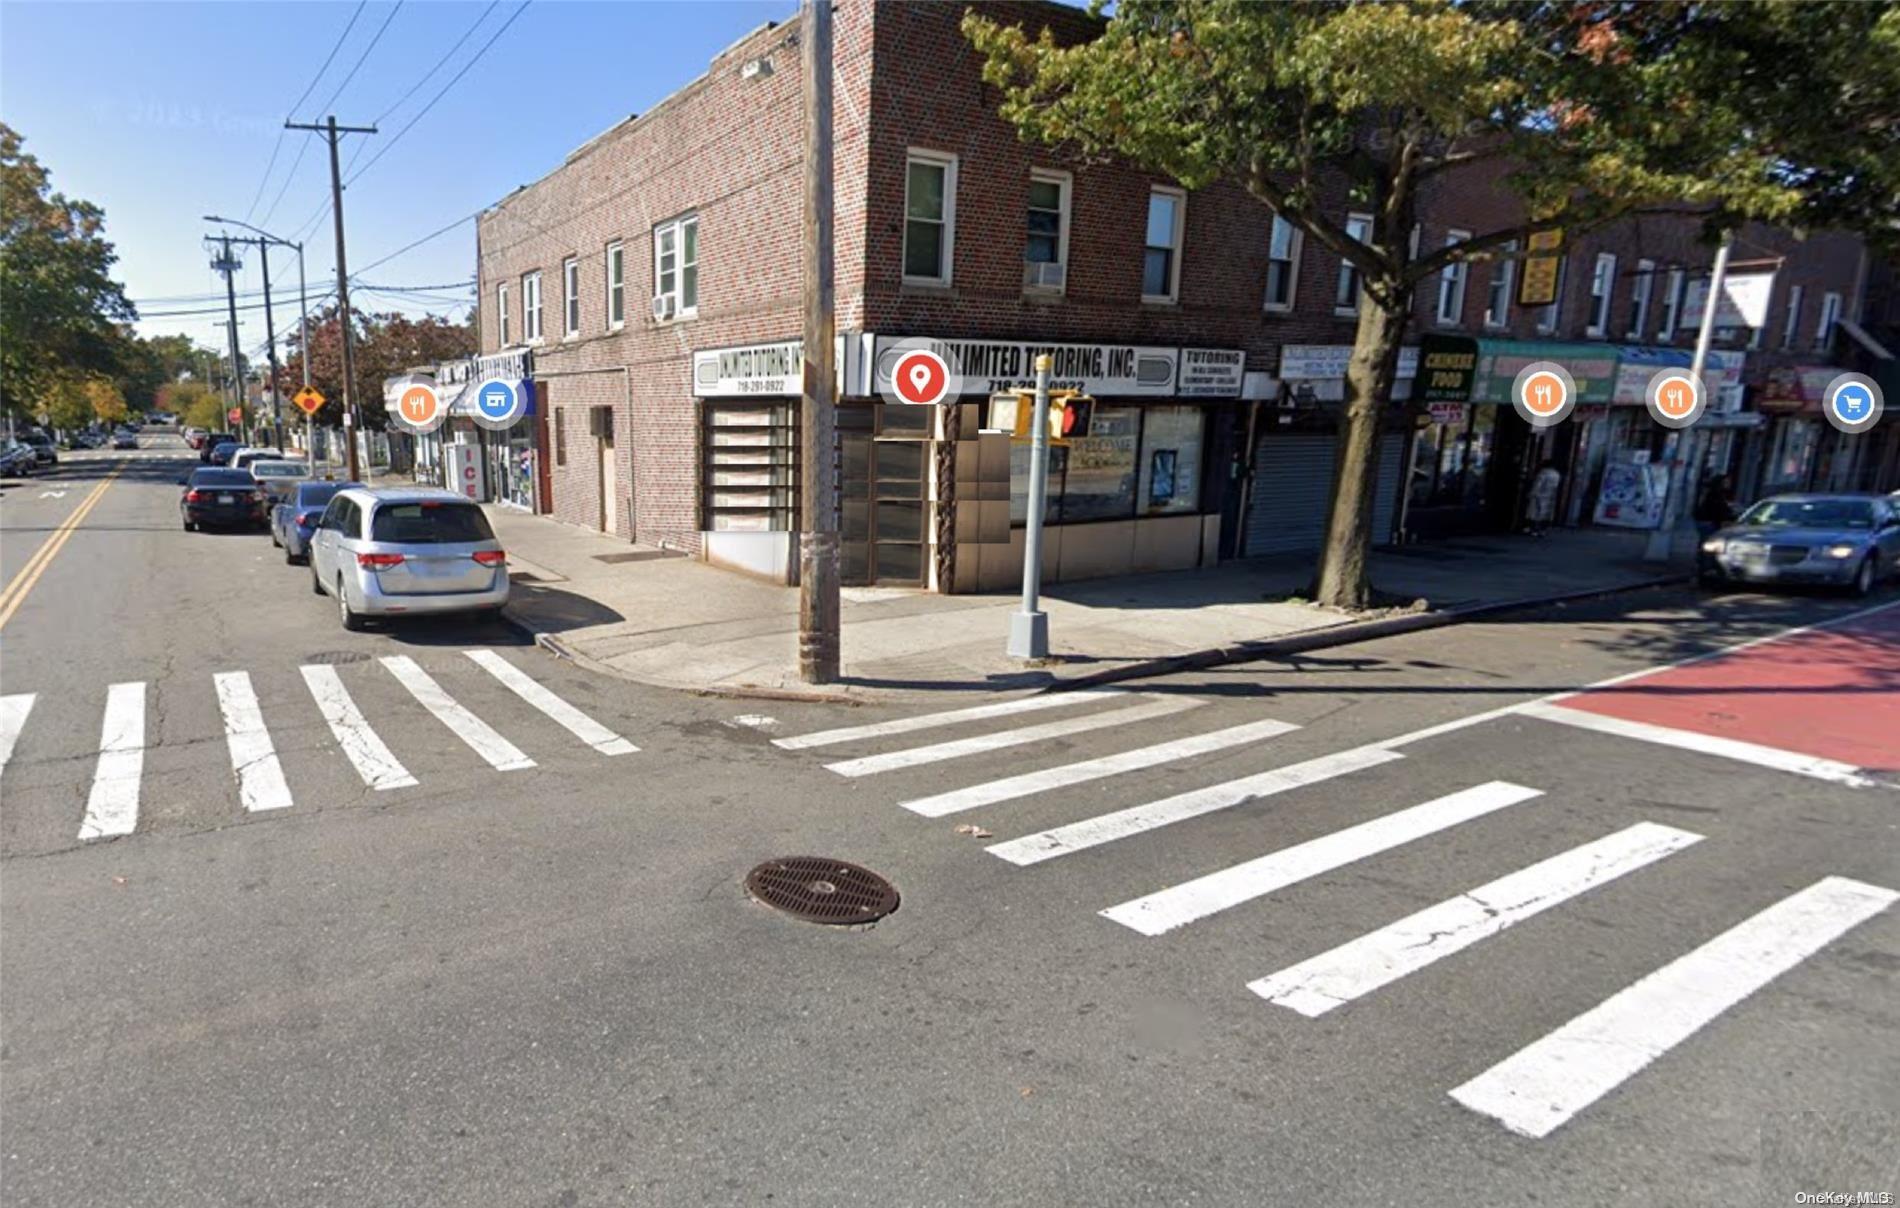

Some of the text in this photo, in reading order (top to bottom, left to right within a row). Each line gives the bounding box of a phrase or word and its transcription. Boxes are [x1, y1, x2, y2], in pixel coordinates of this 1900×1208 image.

[1107, 348, 1136, 378] INC.
[1187, 350, 1240, 365] TUTORING
[989, 380, 1086, 392] 718-290922
[465, 447, 477, 498] ICE
